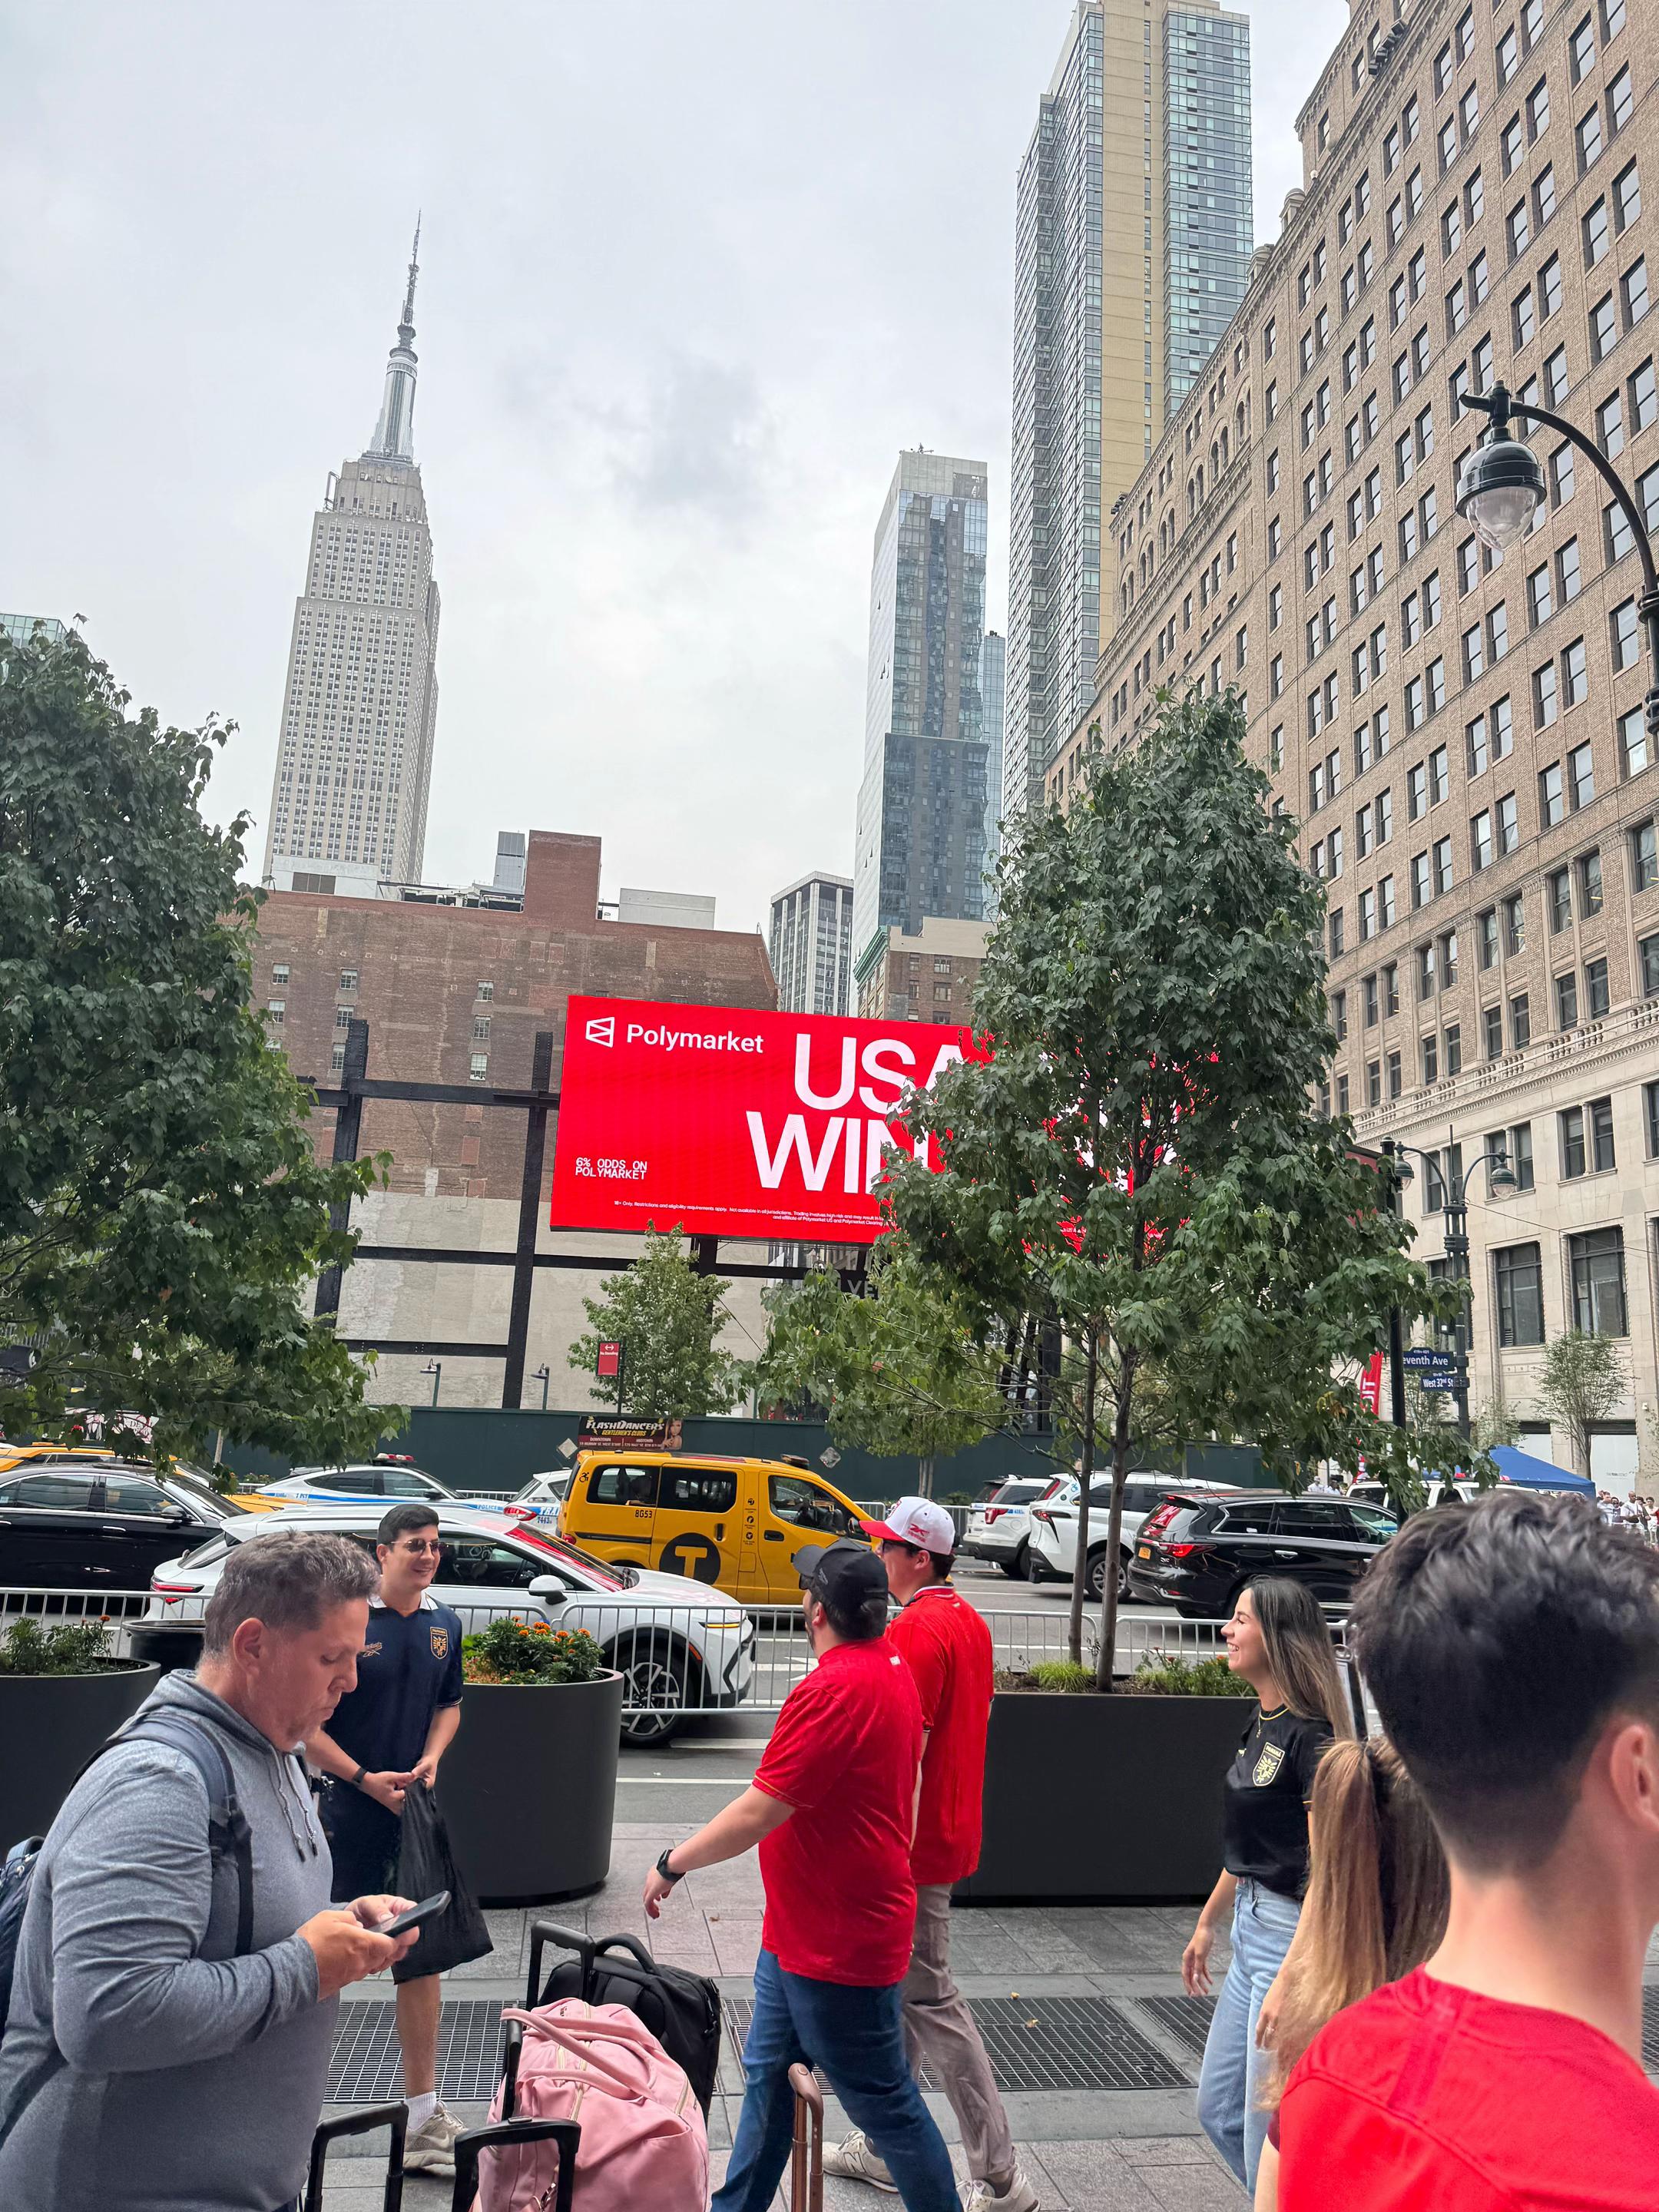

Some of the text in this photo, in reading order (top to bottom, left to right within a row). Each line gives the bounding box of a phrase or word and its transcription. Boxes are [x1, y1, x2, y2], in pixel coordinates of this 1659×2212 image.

[627, 1024, 763, 1053] Polymarket
[575, 1157, 647, 1171] 6% ODDS ON
[575, 1166, 647, 1180] POLYMARKET
[1402, 1355, 1449, 1366] eventh Ave
[1422, 1379, 1436, 1388] West
[1448, 1378, 1454, 1387] St
[674, 1545, 708, 1578] T
